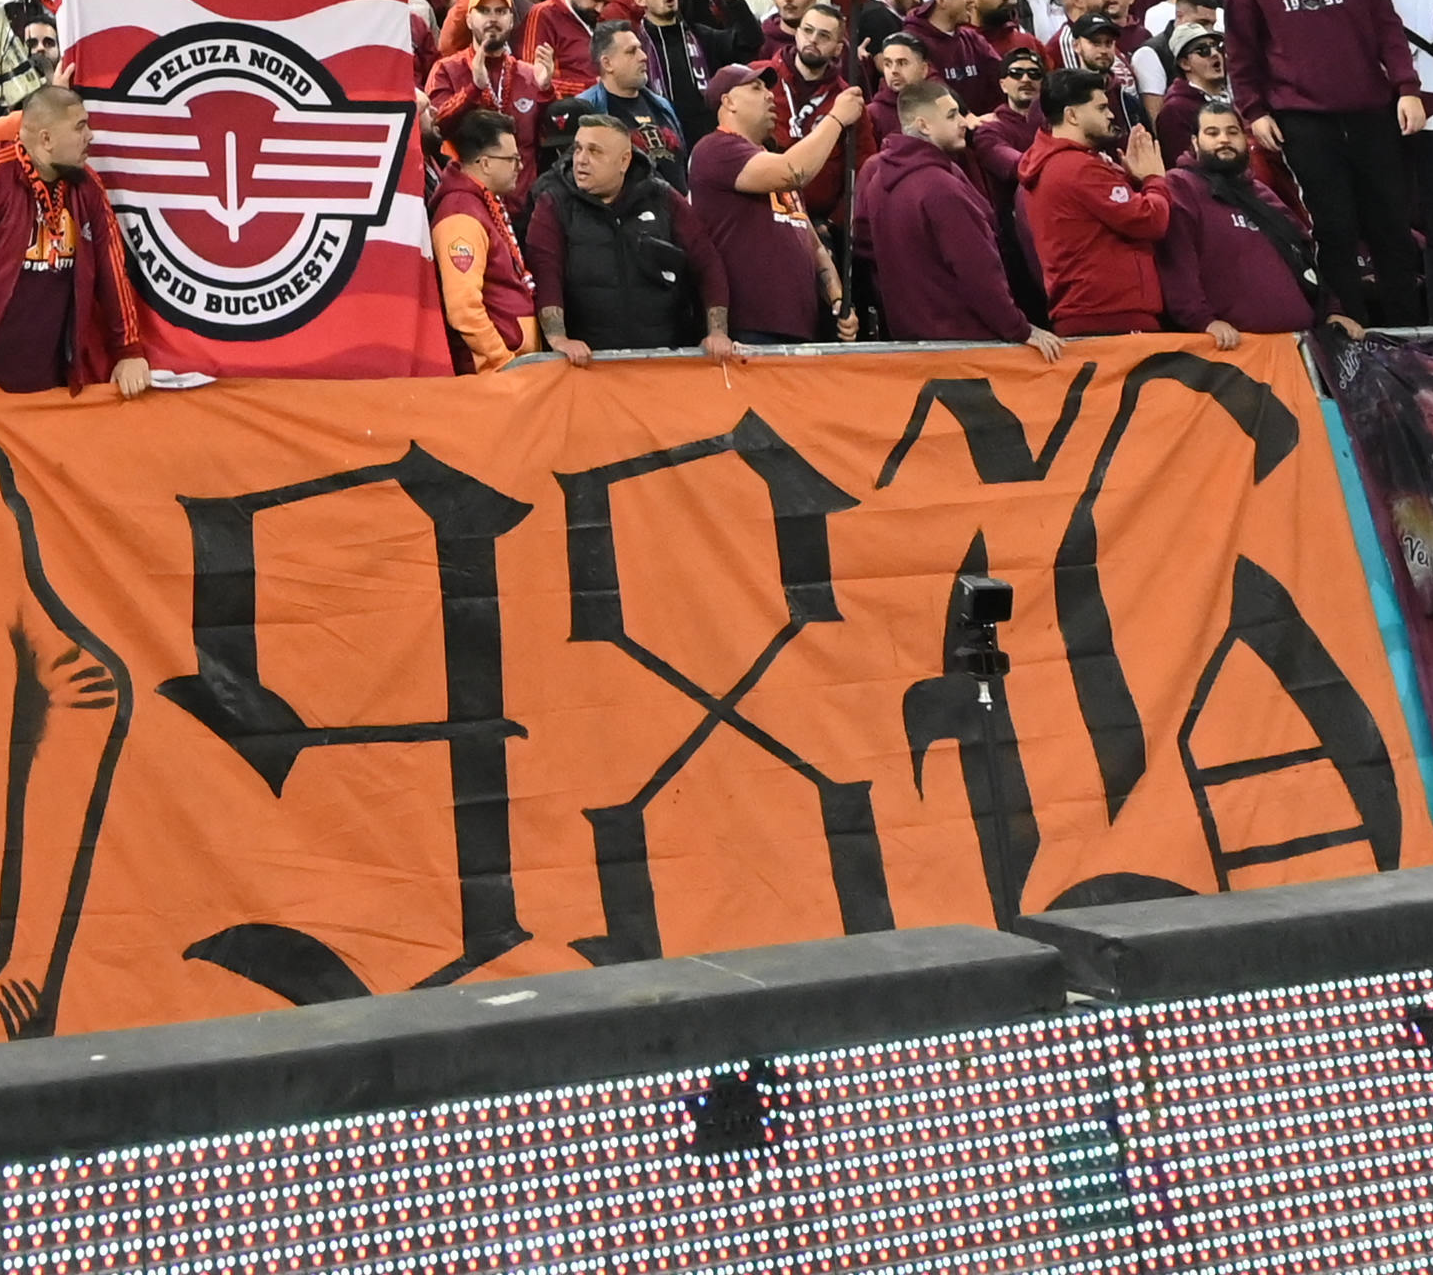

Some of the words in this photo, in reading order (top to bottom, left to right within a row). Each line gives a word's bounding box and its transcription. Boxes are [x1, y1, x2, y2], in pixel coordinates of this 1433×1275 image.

[145, 41, 243, 94] PELUZA
[246, 48, 316, 99] NORD
[125, 223, 198, 308] RAPID
[203, 231, 342, 318] BUCUREȘTI
